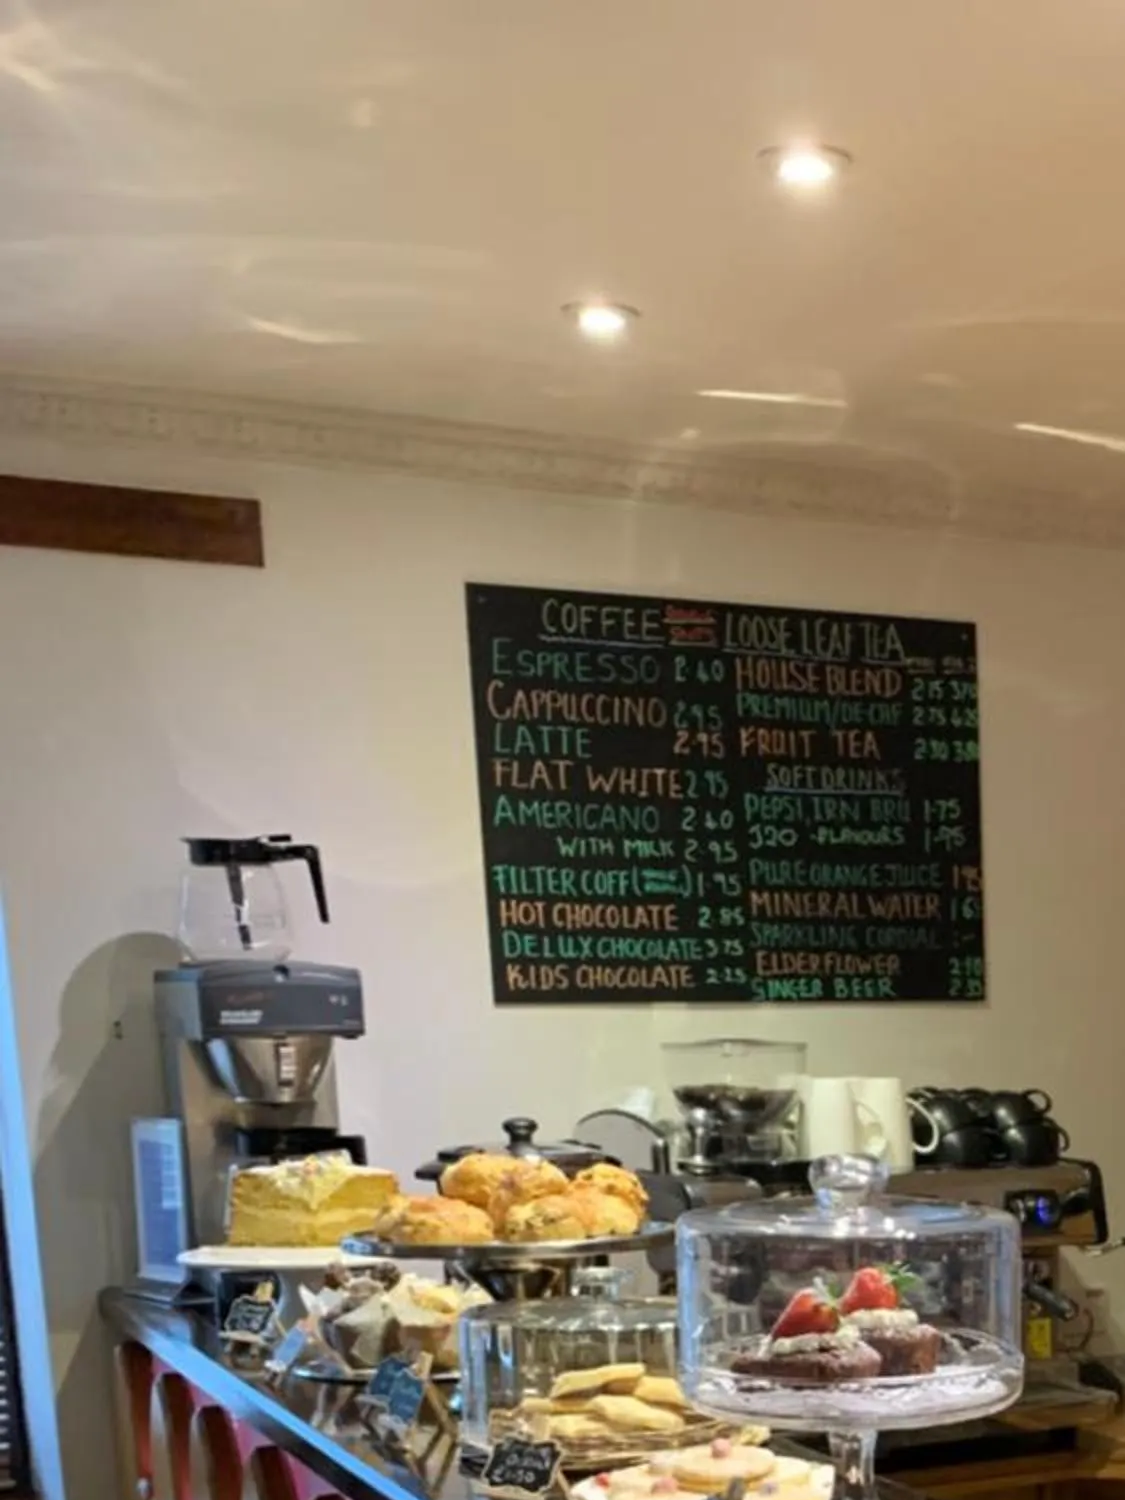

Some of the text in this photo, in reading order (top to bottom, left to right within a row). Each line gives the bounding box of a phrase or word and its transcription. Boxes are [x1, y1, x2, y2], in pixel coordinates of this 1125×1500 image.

[541, 597, 665, 641] COFFEE
[724, 611, 795, 656] LOOSE
[801, 617, 854, 659] LEAF
[859, 620, 906, 660] TEA
[491, 636, 661, 684] ESPRESSO
[734, 656, 820, 693] HOUSE
[825, 663, 903, 698] BLEND
[487, 679, 667, 728] CAPPUCCINO
[494, 721, 592, 759] LATTE
[739, 725, 817, 759] FRUIT
[831, 728, 881, 761] TEA
[492, 757, 574, 790] FLAT
[586, 764, 684, 799] WHITE
[766, 762, 818, 788] SOFT
[493, 794, 660, 833] AMERICANO
[555, 835, 615, 857] WITH
[623, 838, 675, 858] MILK
[492, 863, 577, 898] FILTER
[499, 899, 546, 928] HOT
[552, 901, 680, 931] CHOCOLATE
[750, 890, 867, 919] MINERAL
[867, 893, 942, 921] WATER
[595, 935, 703, 960] CHOCOLATE
[505, 963, 569, 990] KIDS
[575, 963, 697, 988] CHOCOLATE
[833, 975, 897, 998] BEER
